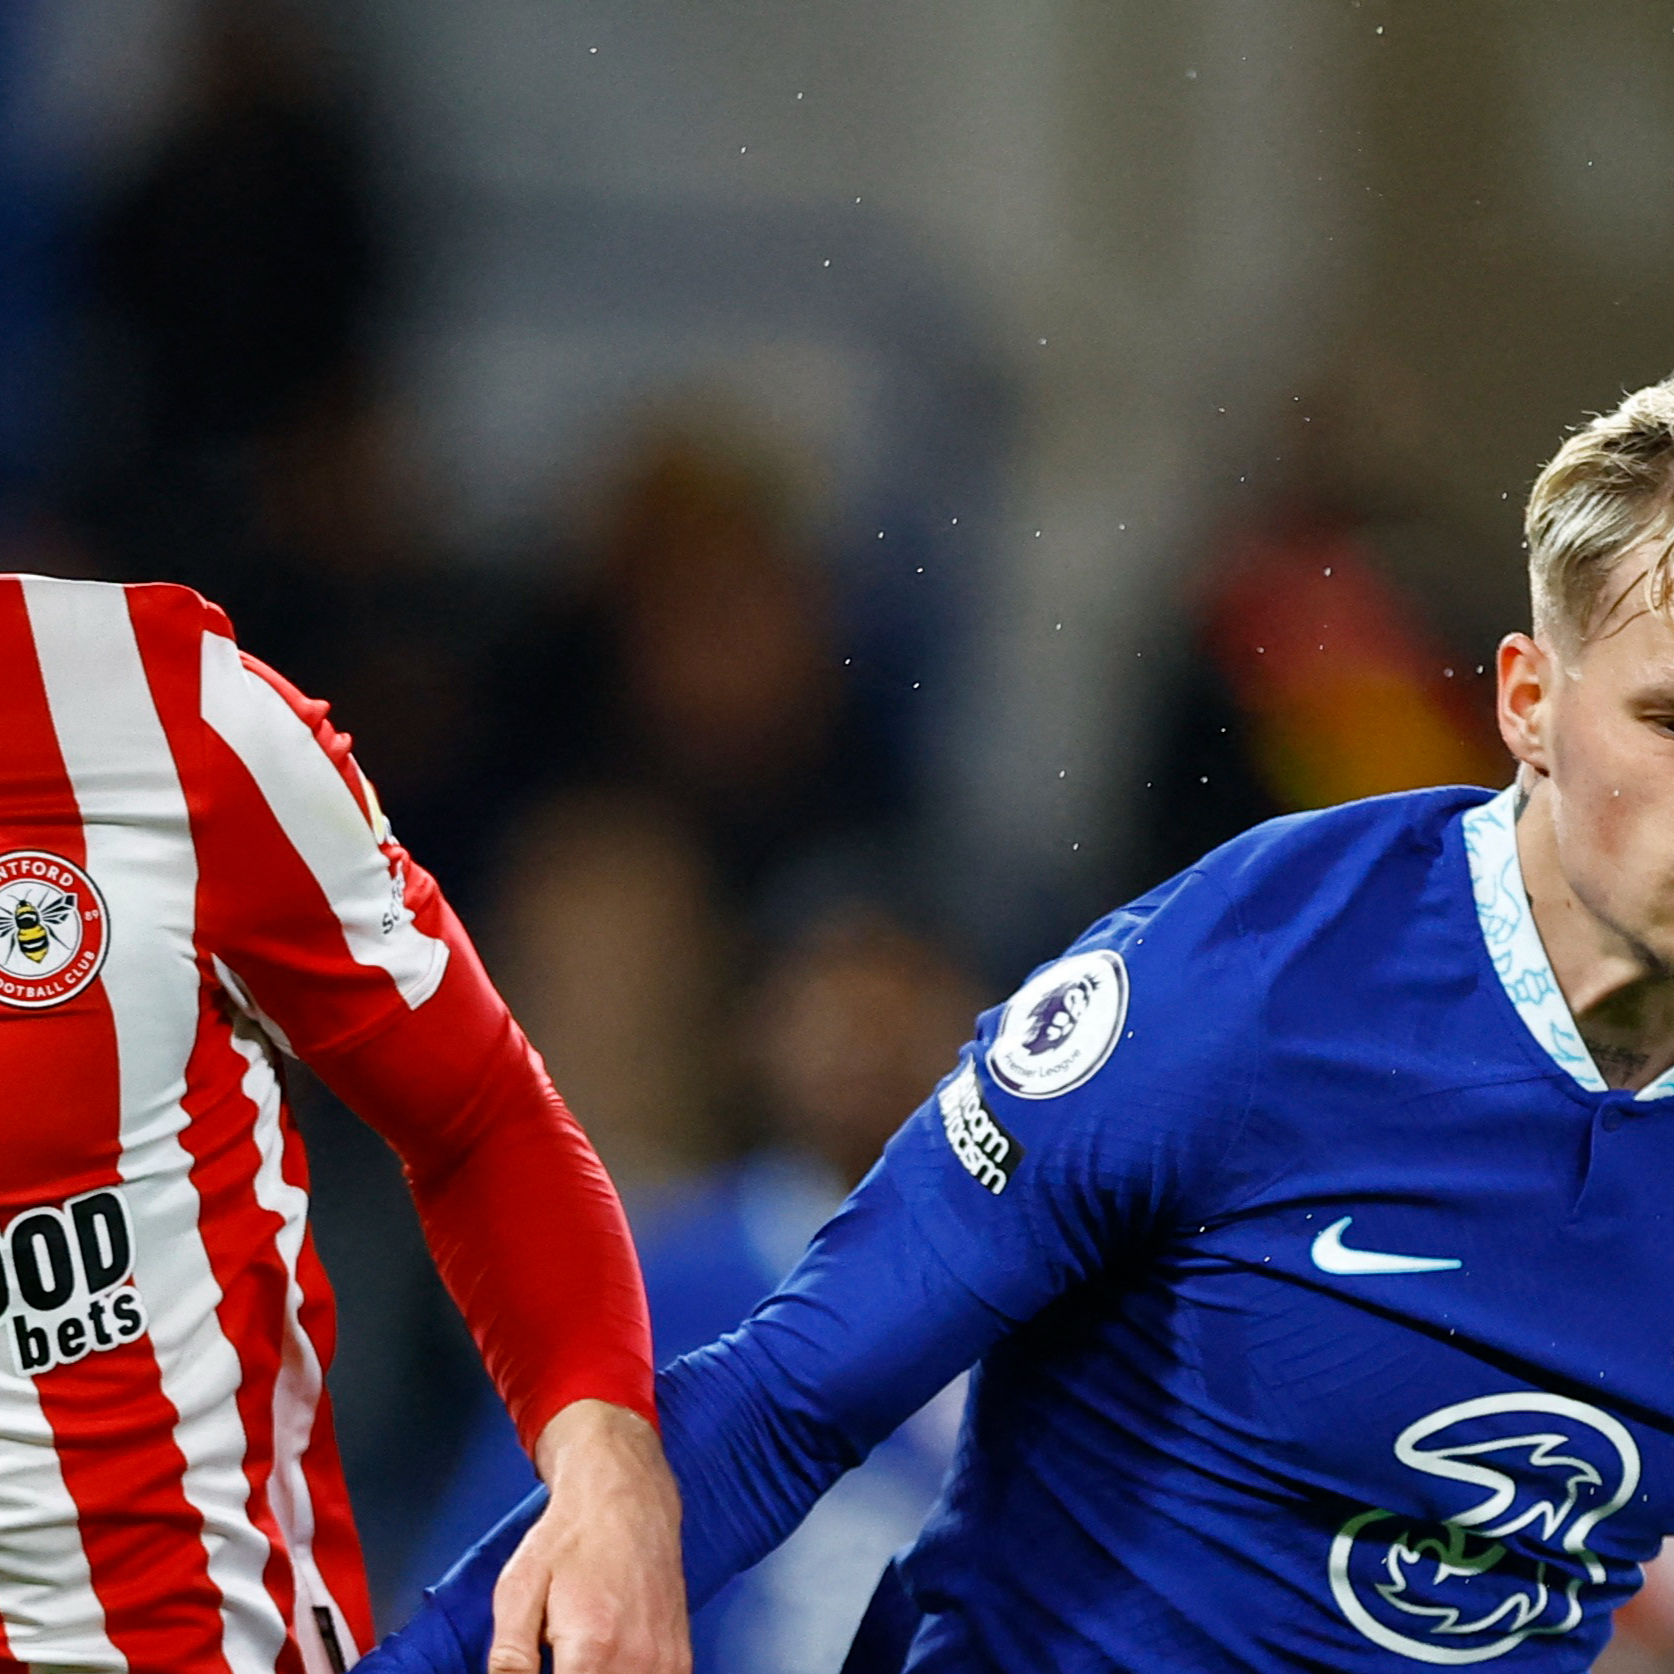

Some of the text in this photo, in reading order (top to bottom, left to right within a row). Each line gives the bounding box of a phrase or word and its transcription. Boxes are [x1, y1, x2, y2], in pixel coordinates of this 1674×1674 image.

[64, 951, 95, 984] CLUB
[1039, 1049, 1081, 1078] League
[12, 1291, 143, 1369] bets
